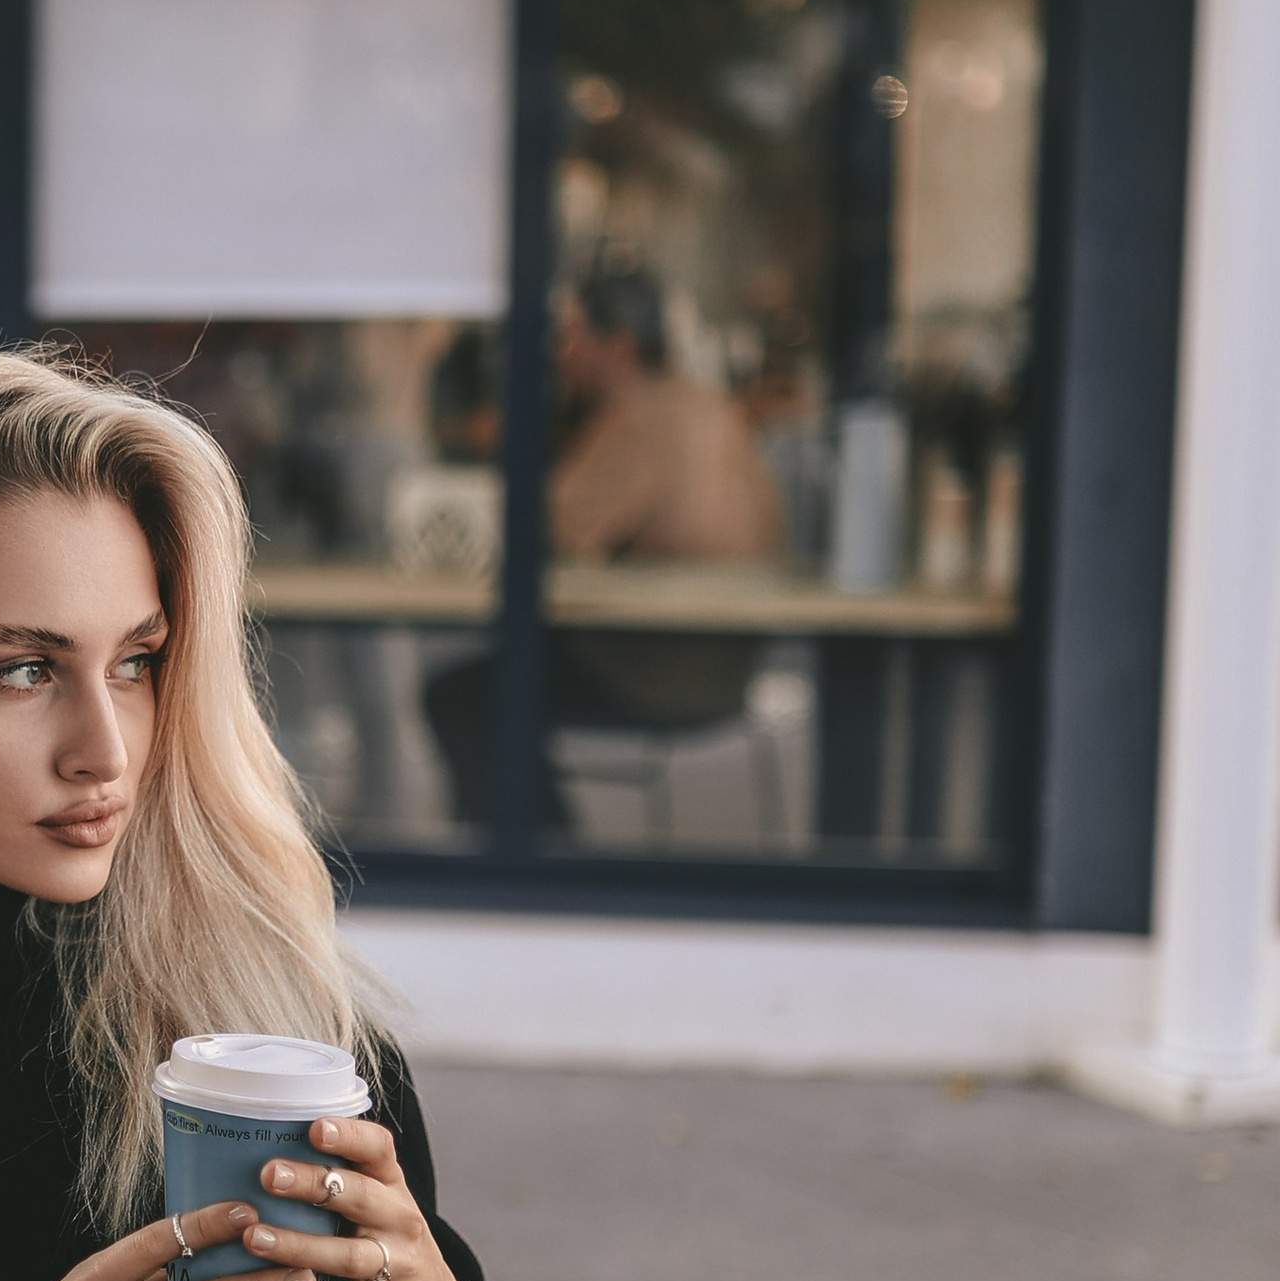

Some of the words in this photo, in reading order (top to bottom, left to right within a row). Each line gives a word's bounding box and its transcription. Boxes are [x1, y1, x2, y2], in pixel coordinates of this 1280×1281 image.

[205, 1124, 251, 1141] Always
[255, 1129, 271, 1141] fill
[276, 1132, 306, 1144] your
